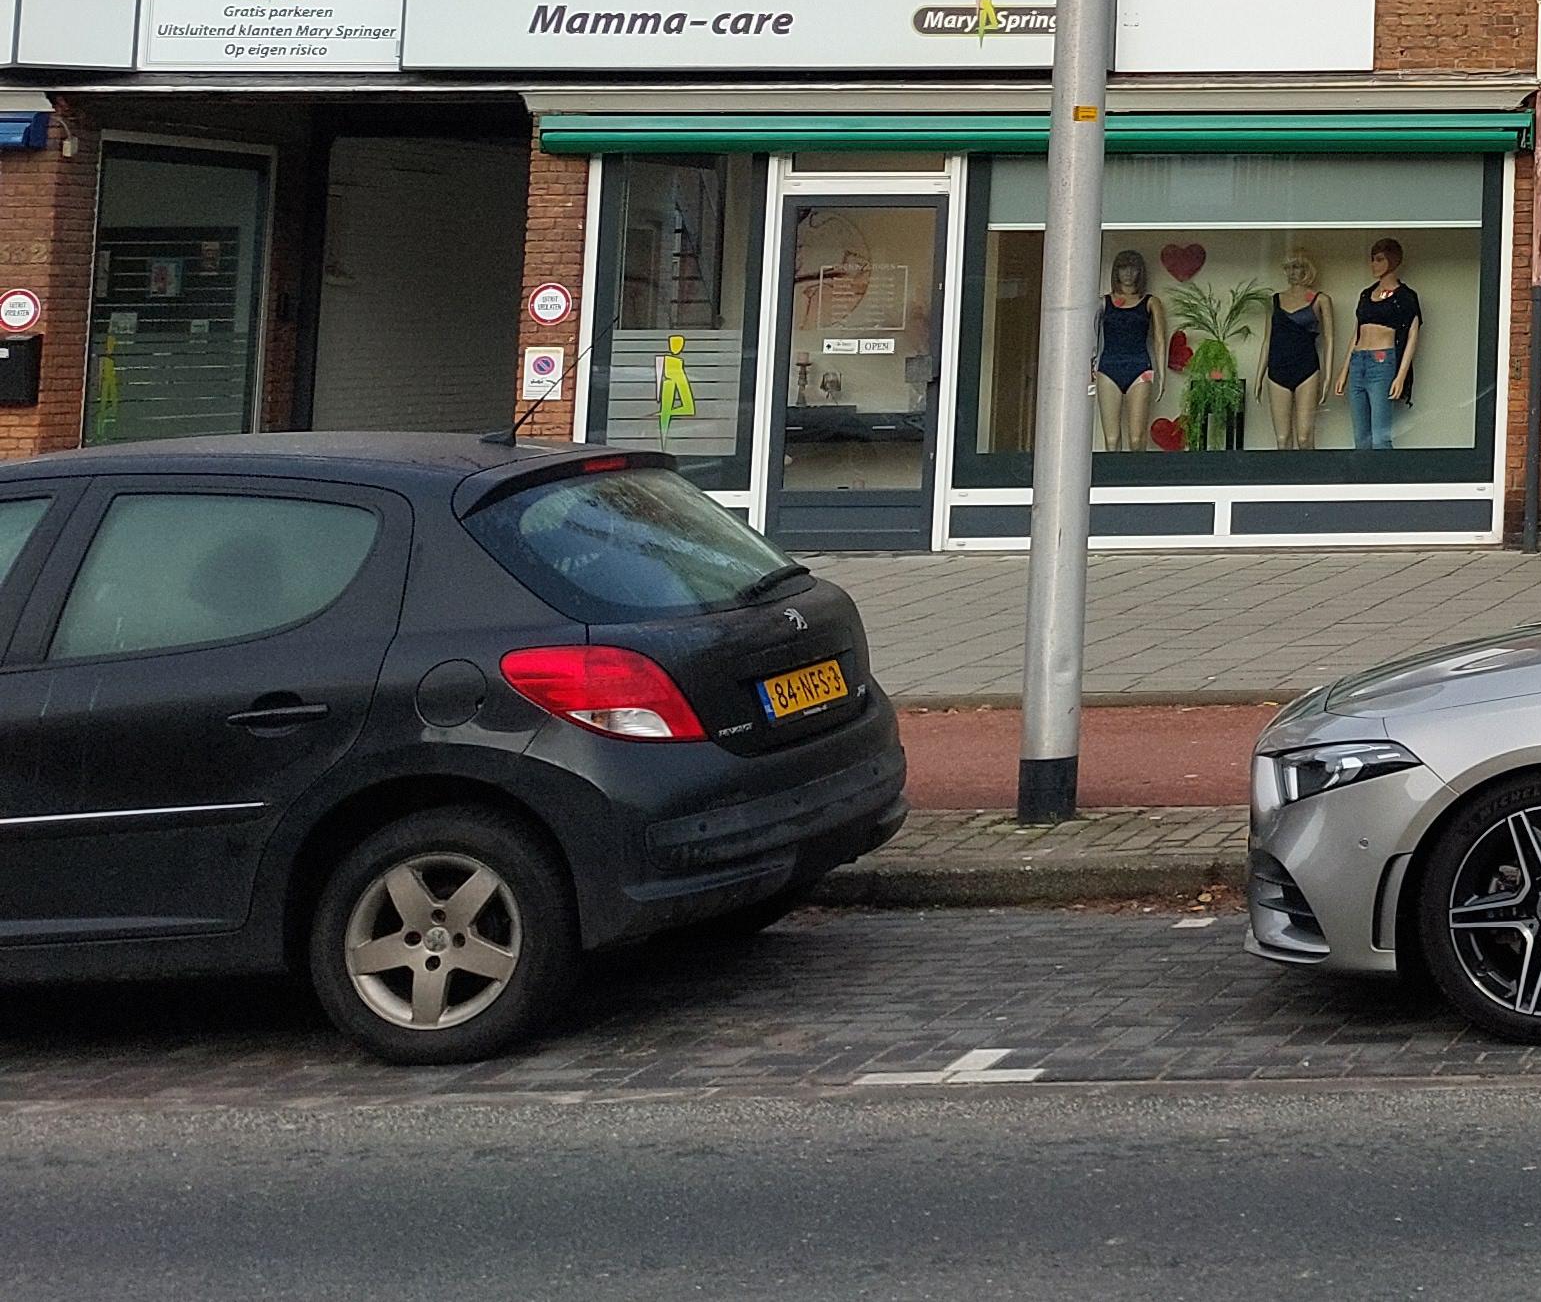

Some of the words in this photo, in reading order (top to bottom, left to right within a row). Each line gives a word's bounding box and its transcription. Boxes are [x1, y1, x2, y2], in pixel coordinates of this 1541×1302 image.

[223, 6, 265, 18] Gratis
[268, 6, 333, 20] parkeren
[528, 5, 794, 34] Mamma-care
[923, 11, 977, 32] Mary
[996, 10, 1056, 32] Spring
[157, 24, 235, 36] Uitsluitend
[238, 24, 292, 37] klanten
[296, 24, 332, 39] Mary
[335, 25, 397, 39] Springer
[224, 43, 245, 57] Op
[248, 43, 287, 58] eigen
[289, 43, 328, 56] risico
[865, 342, 889, 351] OPEN
